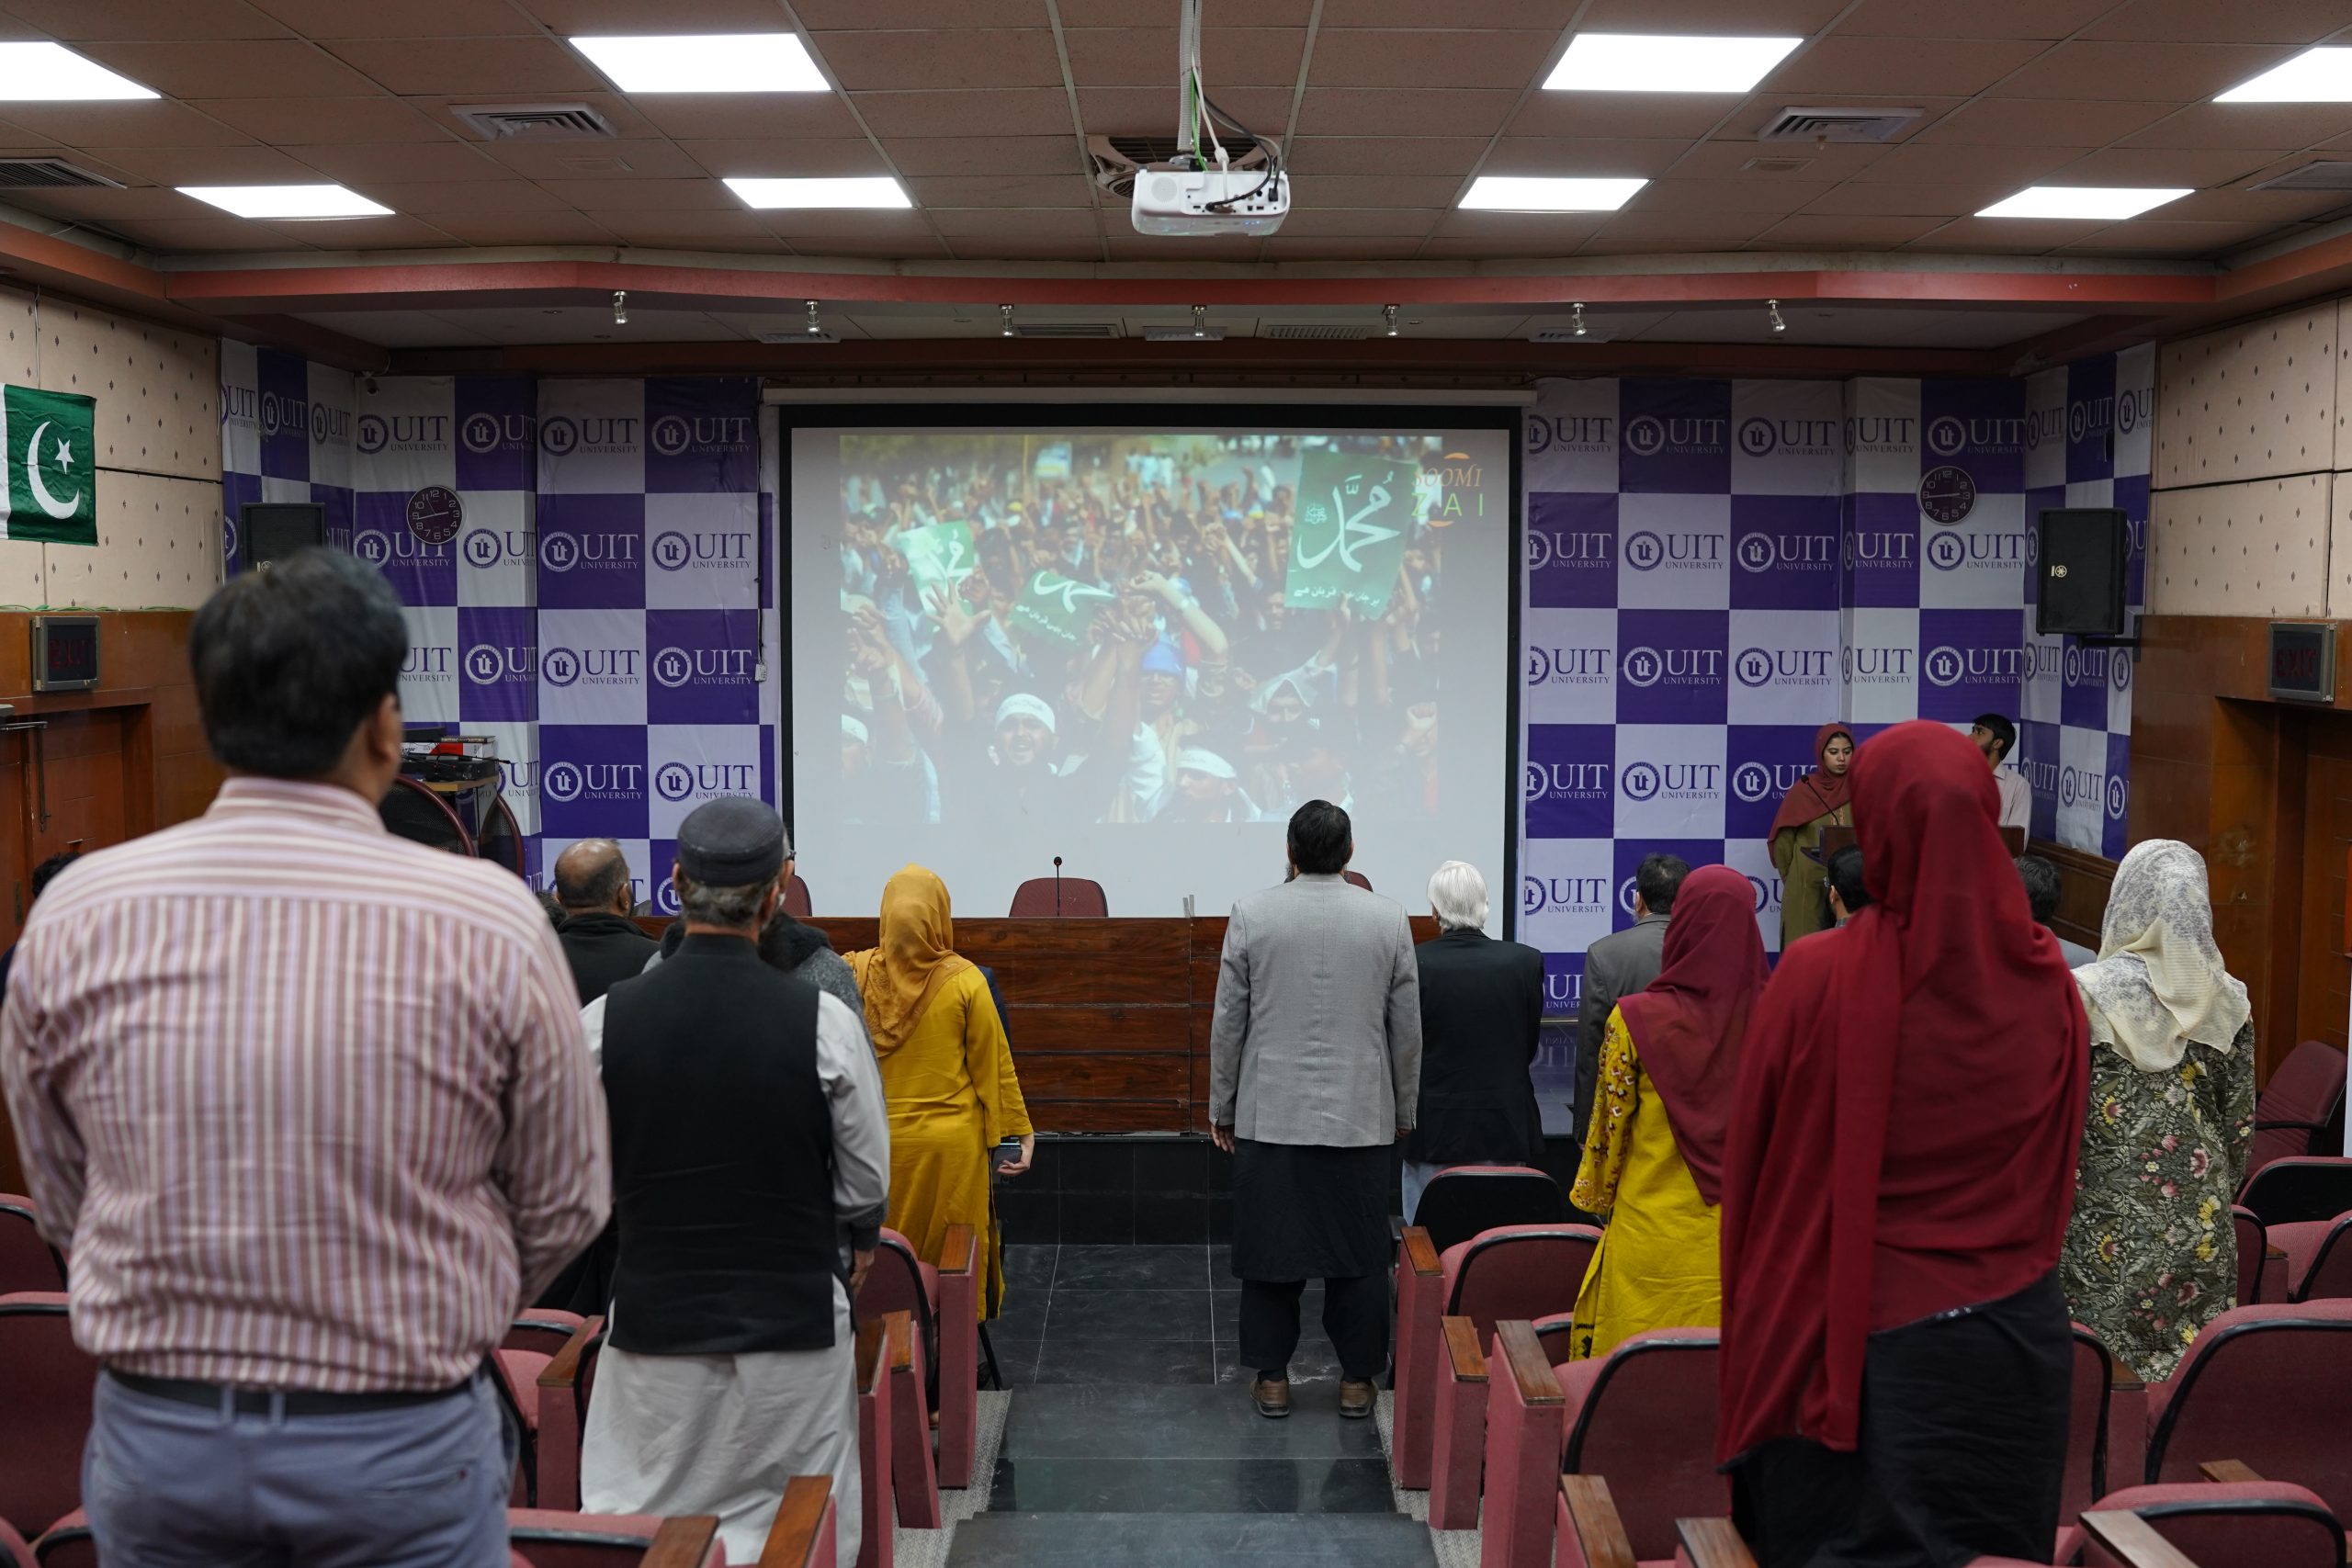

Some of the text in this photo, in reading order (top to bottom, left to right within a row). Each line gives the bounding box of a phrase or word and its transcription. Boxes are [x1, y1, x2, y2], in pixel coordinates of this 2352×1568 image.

[228, 386, 255, 417] UIT
[280, 397, 306, 428] UIT
[2086, 397, 2113, 429] UIT
[328, 406, 350, 437] UIT
[391, 416, 447, 442] UIT
[581, 419, 638, 443] UIT
[694, 417, 750, 443] UIT
[1554, 418, 1612, 443] UIT
[1667, 419, 1725, 446] UIT
[1779, 420, 1836, 446] UIT
[1855, 417, 1914, 443] UIT
[1968, 419, 2026, 445] UIT
[2041, 408, 2064, 436] UIT
[1554, 445, 1611, 454] UNIVERSITY
[1667, 446, 1725, 455] UNIVERSITY
[1968, 446, 2024, 455] UNIVERSITY
[414, 501, 424, 510] 10
[449, 500, 456, 508] 2
[424, 529, 431, 537] 7
[450, 520, 457, 528] 4
[581, 535, 639, 559] UIT
[694, 534, 752, 558] UIT
[1553, 533, 1611, 558] UIT
[1666, 535, 1724, 560] UIT
[1778, 536, 1834, 561] UIT
[1856, 533, 1914, 559] UIT
[1968, 534, 2024, 559] UIT
[392, 558, 450, 567] UNIVERSITY
[1553, 560, 1611, 569] UNIVERSITY
[1666, 561, 1724, 570] UNIVERSITY
[1777, 563, 1834, 571] UNIVERSITY
[1855, 560, 1913, 569] UNIVERSITY
[1967, 560, 2024, 569] UNIVERSITY
[582, 650, 639, 674] UIT
[694, 649, 752, 674] UIT
[1553, 649, 1611, 674] UIT
[1665, 649, 1723, 675] UIT
[1776, 651, 1833, 676] UIT
[1855, 649, 1913, 674] UIT
[1966, 649, 2022, 675] UIT
[2039, 647, 2060, 671] UIT
[2081, 649, 2107, 678] UIT
[584, 765, 642, 789] UIT
[697, 765, 753, 789] UIT
[1551, 764, 1608, 789] UIT
[1663, 765, 1720, 790] UIT
[2033, 761, 2057, 791] UIT
[2078, 771, 2102, 801] UIT
[1550, 791, 1608, 799] UNIVERSITY
[1550, 879, 1606, 903] UIT
[1548, 975, 1583, 1000] UI
